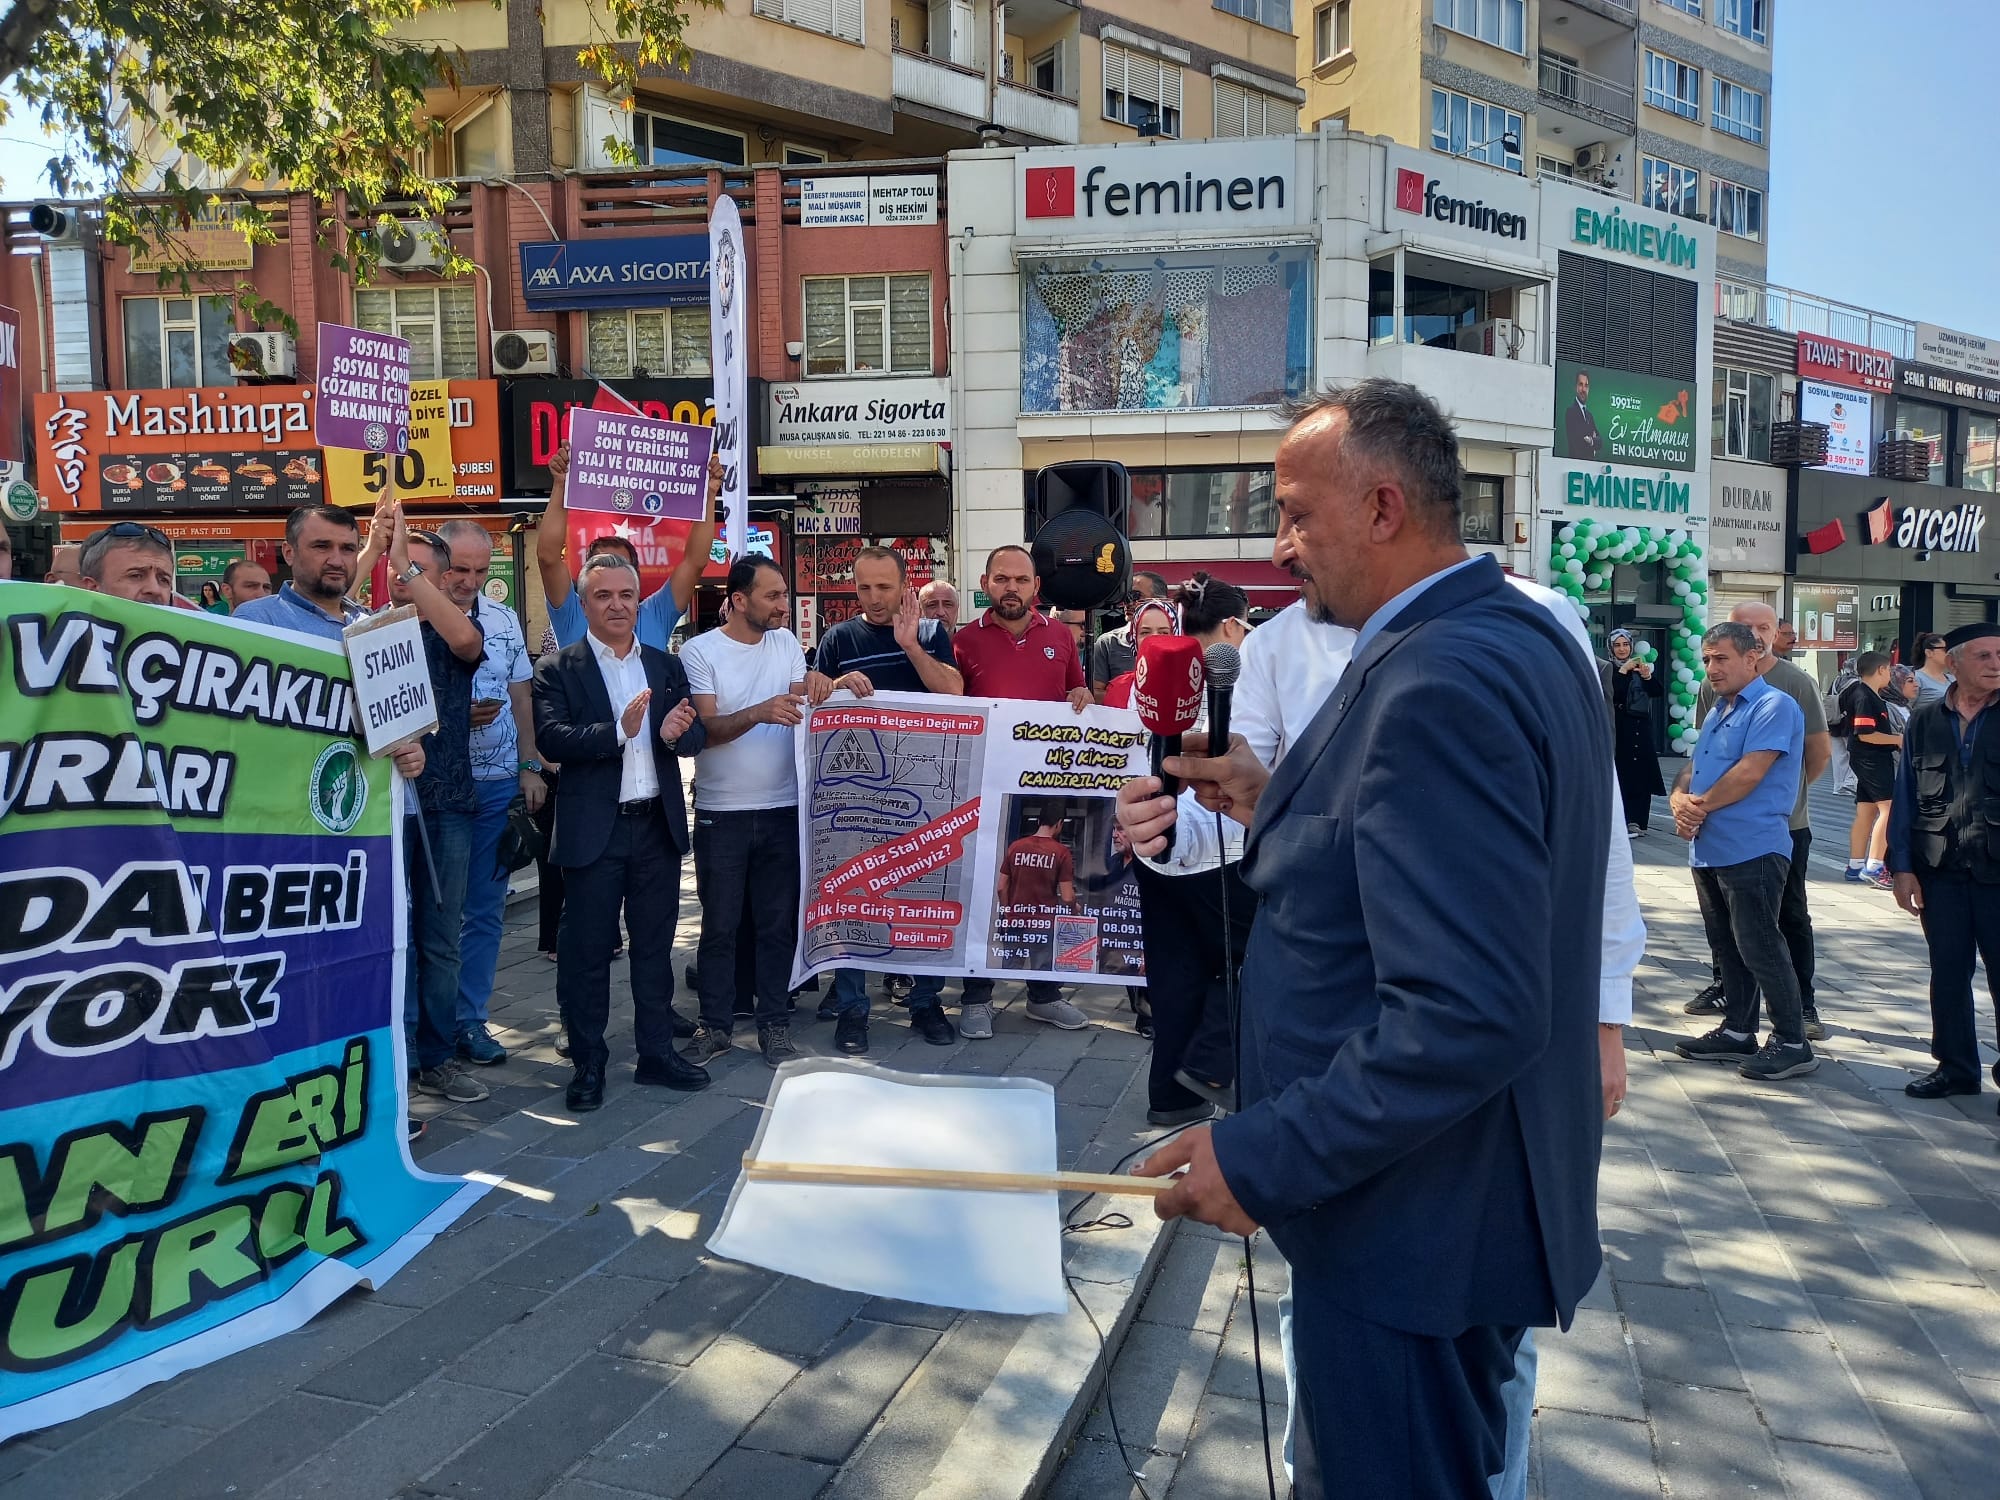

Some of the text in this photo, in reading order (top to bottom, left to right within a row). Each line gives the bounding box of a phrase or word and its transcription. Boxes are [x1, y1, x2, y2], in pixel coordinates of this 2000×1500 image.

[830, 189, 866, 198] MUHASEBECİ
[872, 187, 934, 198] MEHTAP TOLU
[1082, 166, 1284, 217] feminen
[808, 199, 862, 211] MALİ MÜŞAVİR
[879, 202, 928, 217] DİŞ HEKİMİ
[1424, 180, 1527, 241] feminen
[805, 214, 865, 224] AYDEMİR AKSAÇ
[1573, 206, 1697, 270] EMİNEVİM
[528, 267, 561, 285] AXA
[568, 261, 711, 284] AXA SİGORTA
[1938, 332, 1958, 344] UZMAN
[349, 336, 396, 361] SOSYAL
[332, 355, 380, 380] SOSYAL
[1803, 339, 1895, 381] TAVAF TURİZM
[321, 373, 378, 401] ÇÖZMEK
[1903, 370, 1925, 388] SEMA
[410, 388, 442, 401] ÖZEL
[1807, 386, 1830, 397] SOSYAL
[1831, 390, 1857, 403] MEDYADA
[416, 405, 445, 420] DİYE
[779, 399, 946, 424] Ankara Sigorta
[598, 420, 689, 444] HAK GASBINA
[779, 433, 800, 441] MUSA
[801, 432, 837, 442] ÇALIŞKAN
[858, 431, 872, 439] TEL:
[873, 430, 886, 438] 221
[887, 430, 896, 438] 94
[912, 429, 925, 437] 223
[937, 428, 946, 436] 30
[1608, 415, 1690, 447] Ev Almanın
[594, 435, 689, 460] SON VERİLSİN!
[786, 446, 921, 461] YÜKSEL GÖKDELEN
[1612, 443, 1687, 462] EN KOLAY YOLU
[363, 449, 425, 493] 50
[459, 460, 493, 476] ŞUBESİ
[577, 450, 702, 479] STAJ VE ÇIRAKLIK SGK
[578, 471, 697, 496] BAŞLANGICI OLSUN
[1567, 464, 1690, 514] EMİNEVİM
[1722, 485, 1772, 512] DURAN
[211, 527, 231, 535] FOOD
[797, 517, 820, 532] HAC
[823, 517, 831, 532] &
[1712, 515, 1752, 531] APARTMANI
[1896, 504, 1986, 561] arçelik
[364, 639, 415, 679] STAJIM
[368, 681, 428, 730] EMEĞİM
[812, 715, 979, 731] Bu T.C Resmi Belgesi Değil mi?
[1014, 722, 1082, 740] SİGORTA
[1046, 746, 1129, 769] HİÇ KİMSE
[823, 861, 864, 895] Şimdi
[863, 853, 889, 871] Biz
[887, 838, 920, 859] Staj
[868, 843, 952, 892] Değilmiyiz?
[1014, 852, 1056, 870] EMEKLİ
[222, 855, 362, 936] BERİ
[807, 899, 955, 924] Bu İlk İşe Giriş Tarihim
[997, 902, 1072, 916] İşe Giriş Tarihi:
[1084, 904, 1100, 917] İşe
[1102, 906, 1128, 920] Giriş
[994, 919, 1051, 929] 08.09.1999
[894, 931, 948, 944] Değil mi?
[993, 932, 1048, 944] Prim: 5975
[1102, 938, 1131, 949] Prim:
[992, 947, 1030, 959] Yaş: 43
